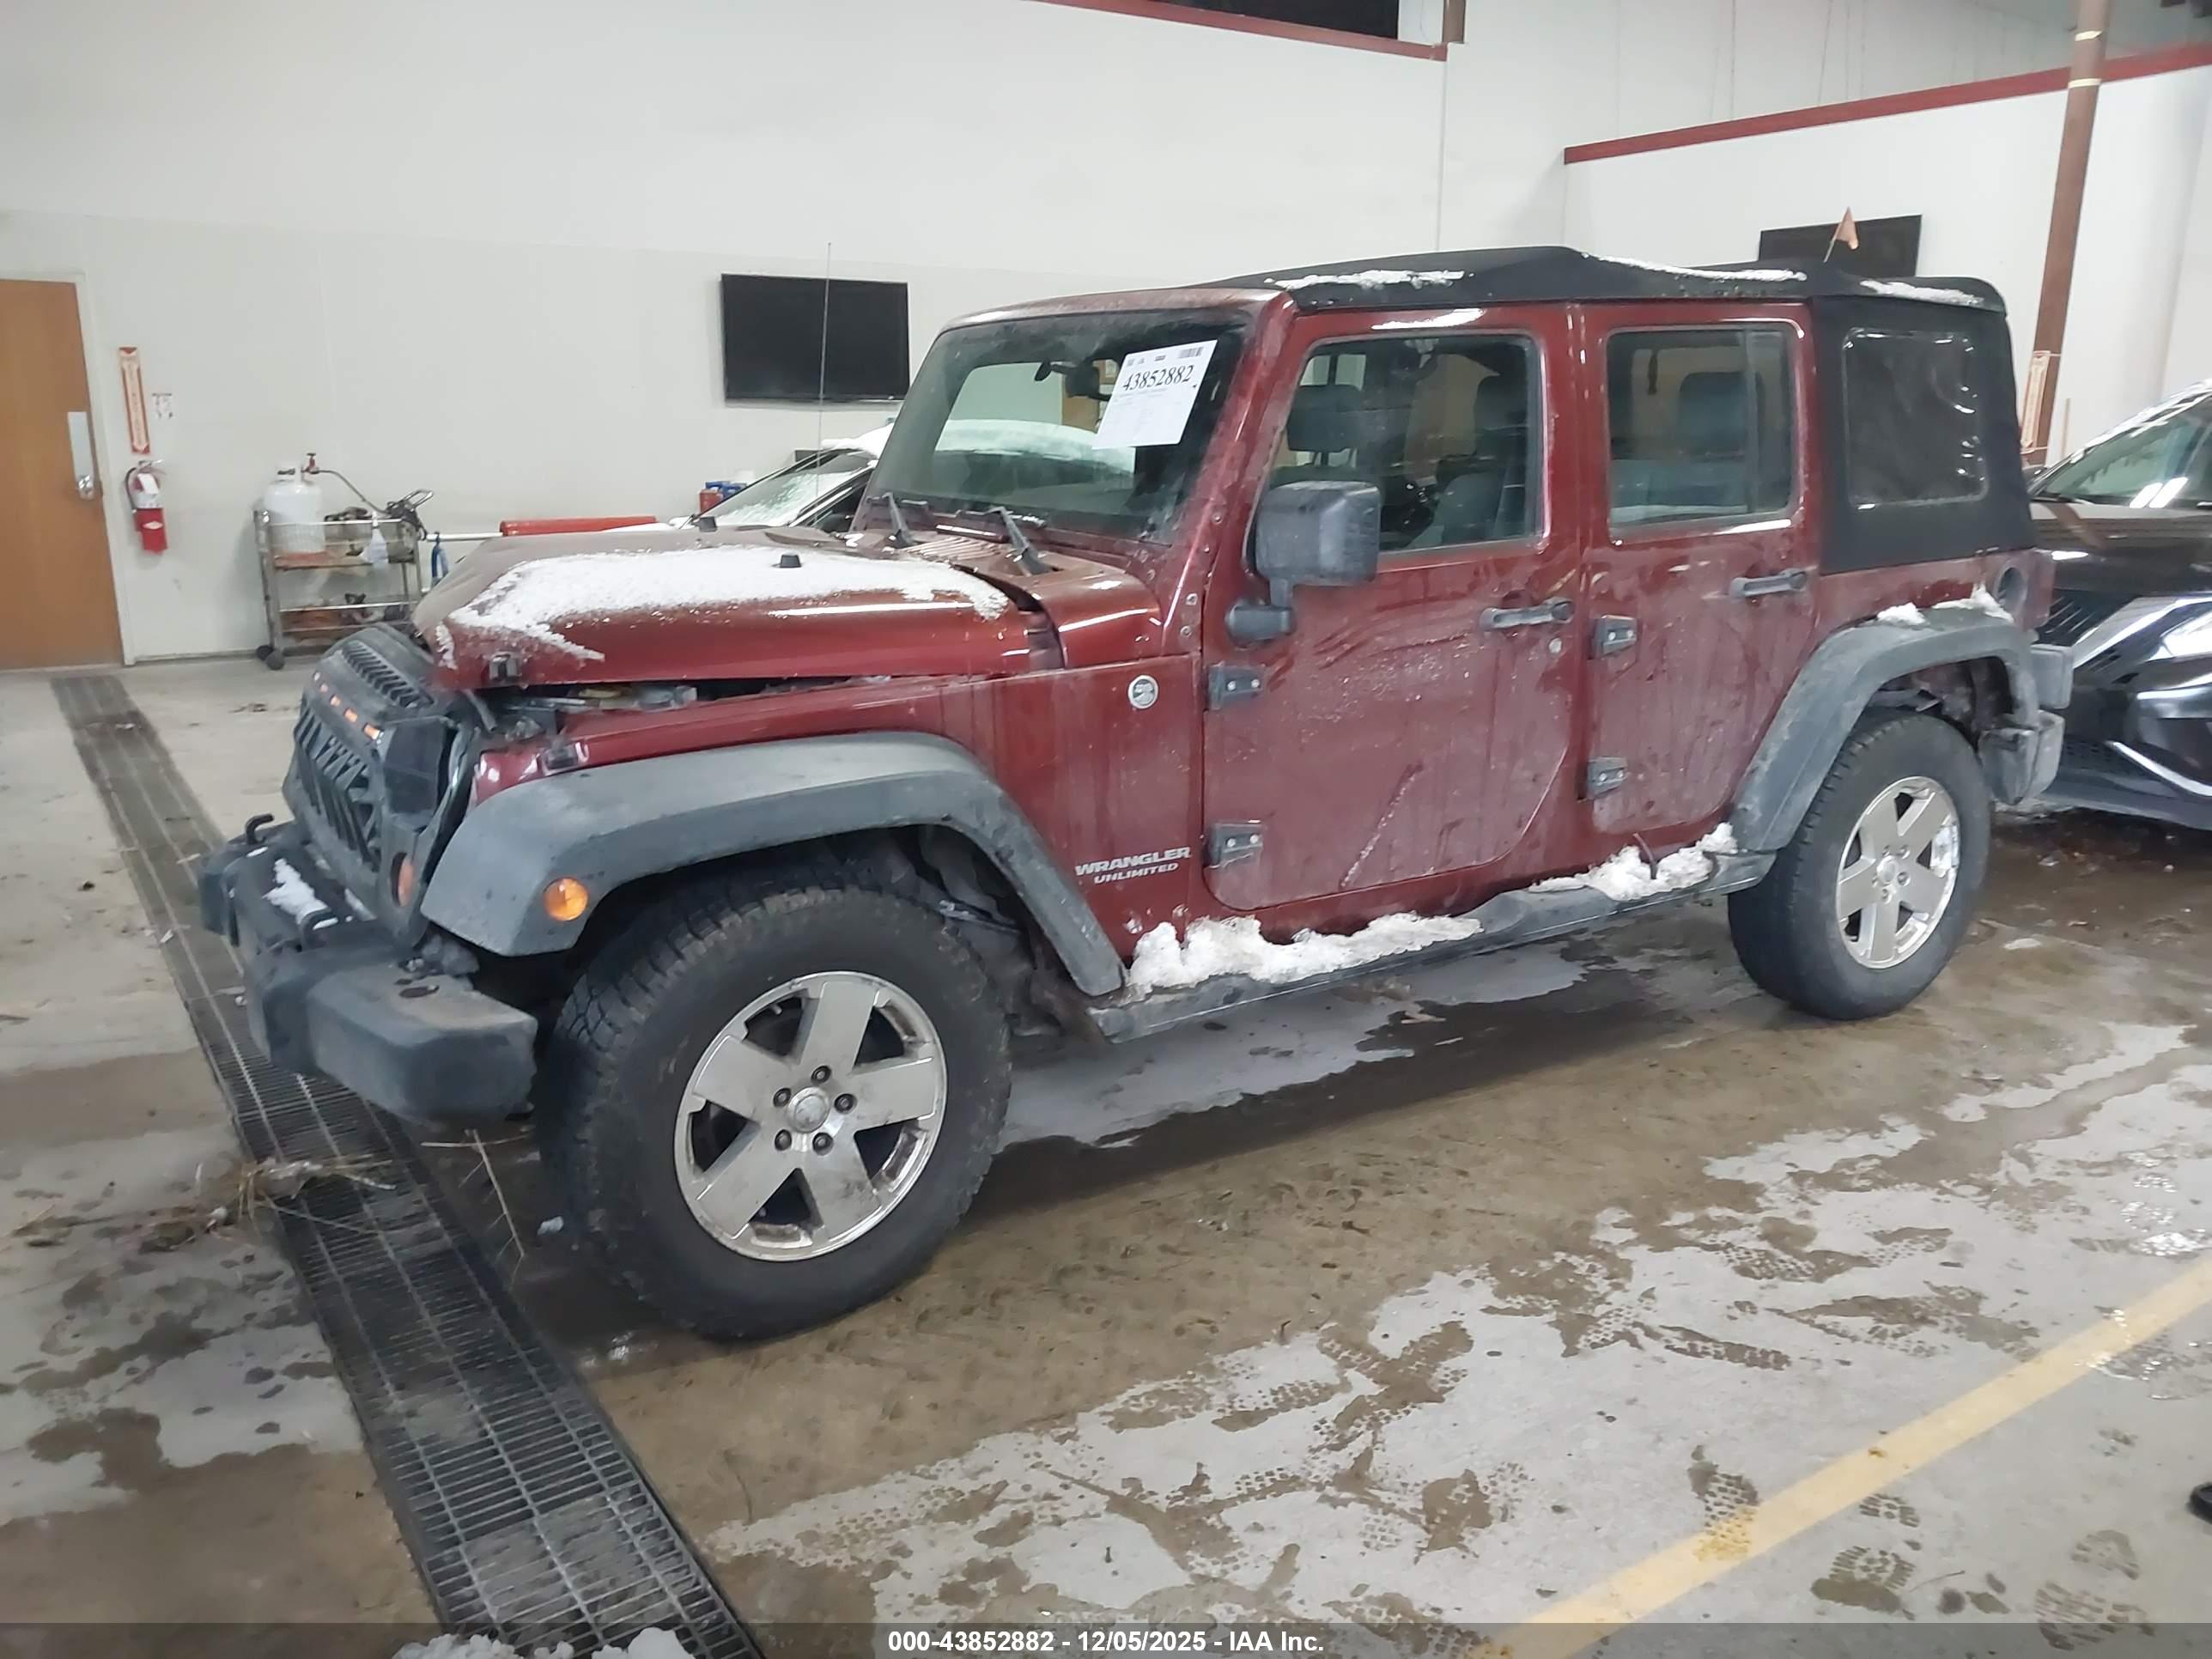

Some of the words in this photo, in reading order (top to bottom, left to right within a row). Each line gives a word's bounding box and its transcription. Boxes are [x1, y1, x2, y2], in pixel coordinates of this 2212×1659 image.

[1122, 364, 1195, 391] 43852882
[1074, 847, 1191, 876] WRANGLER
[1094, 862, 1179, 884] UNLIMITED
